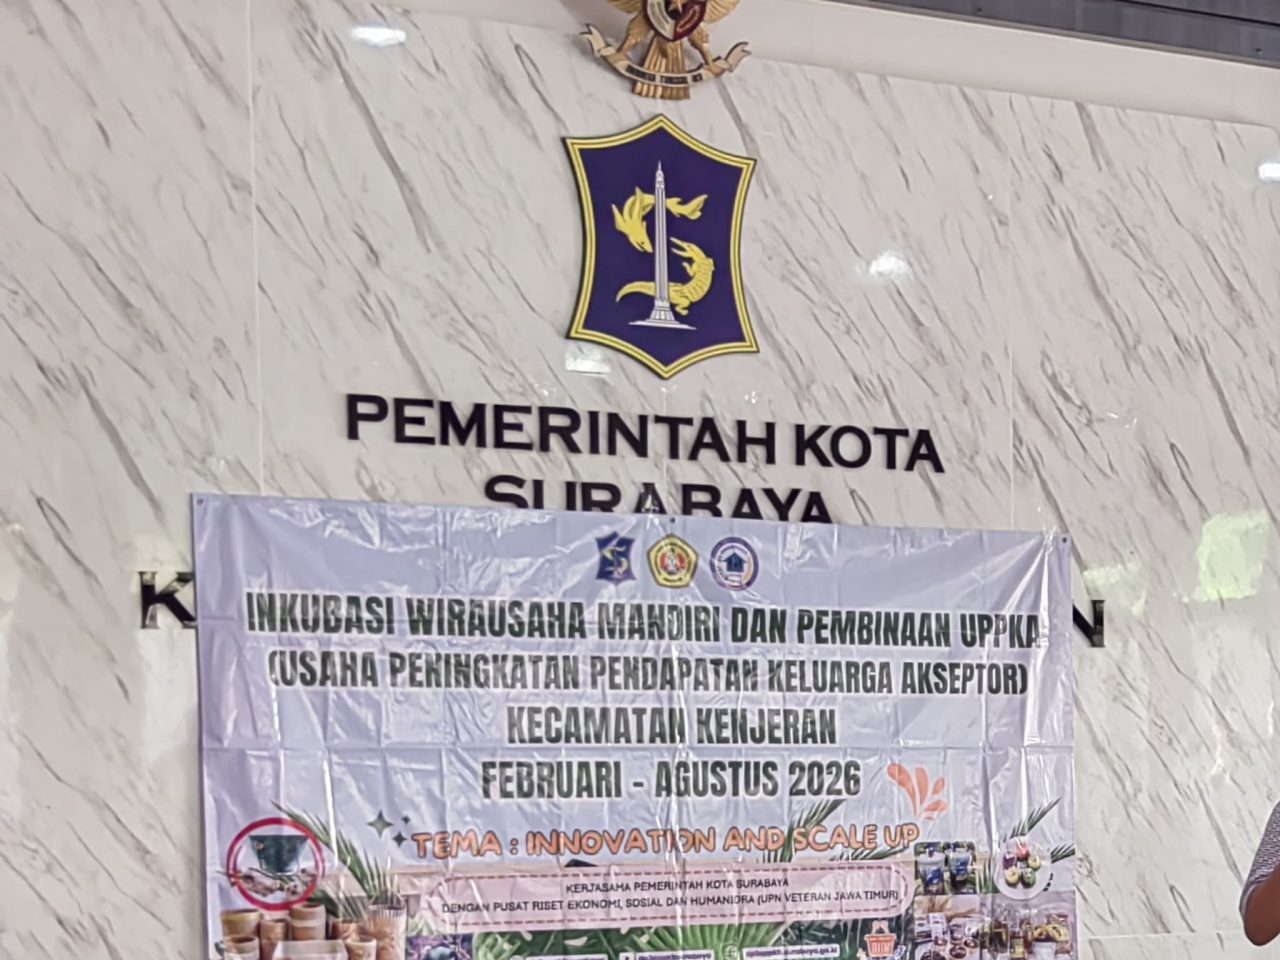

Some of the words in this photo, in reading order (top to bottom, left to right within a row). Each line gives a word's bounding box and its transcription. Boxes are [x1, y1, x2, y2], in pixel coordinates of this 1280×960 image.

[346, 393, 777, 465] PEMERINTAH
[795, 423, 945, 473] KOTA
[484, 474, 833, 523] SURABAYA
[246, 592, 395, 634] INKUBASI
[405, 598, 587, 639] WIRAUSAHA
[598, 602, 720, 643] MANDIRI
[731, 608, 787, 643] DAN
[796, 609, 951, 647] PEMBINAAN
[960, 613, 1042, 649] UPPKA
[269, 650, 379, 687] (USAHA
[389, 652, 579, 689] PENINGKATAN
[590, 656, 758, 692] PENDAPATAN
[767, 659, 893, 694] KELUARGA
[901, 663, 1027, 695] AKSEPTOR)
[507, 705, 686, 744] KECAMATAN
[696, 708, 837, 745] KENJERAN
[481, 760, 622, 798] FEBRUARI
[655, 760, 779, 798] AGUSTUS
[789, 761, 861, 796] 2026
[411, 830, 501, 859] TEMA
[526, 826, 715, 857] INNOVATION
[723, 825, 786, 851] AND
[793, 825, 879, 853] SCALE
[883, 822, 920, 848] UP
[442, 903, 490, 913] DENGAN
[494, 902, 528, 912] PUSAT
[532, 900, 563, 910] RISET
[568, 899, 623, 910] EKONOMI,
[626, 899, 663, 908] SOSIAL
[666, 896, 690, 906] DAN
[757, 893, 781, 906] (UPN
[785, 893, 830, 902] VETERAN
[834, 891, 861, 901] JAWA
[864, 890, 898, 901] TIMUR)
[567, 883, 631, 893] KERJASAMA
[634, 880, 703, 891] PEMERINTAH
[706, 880, 733, 889] KOTA
[736, 878, 789, 889] SURABAYA
